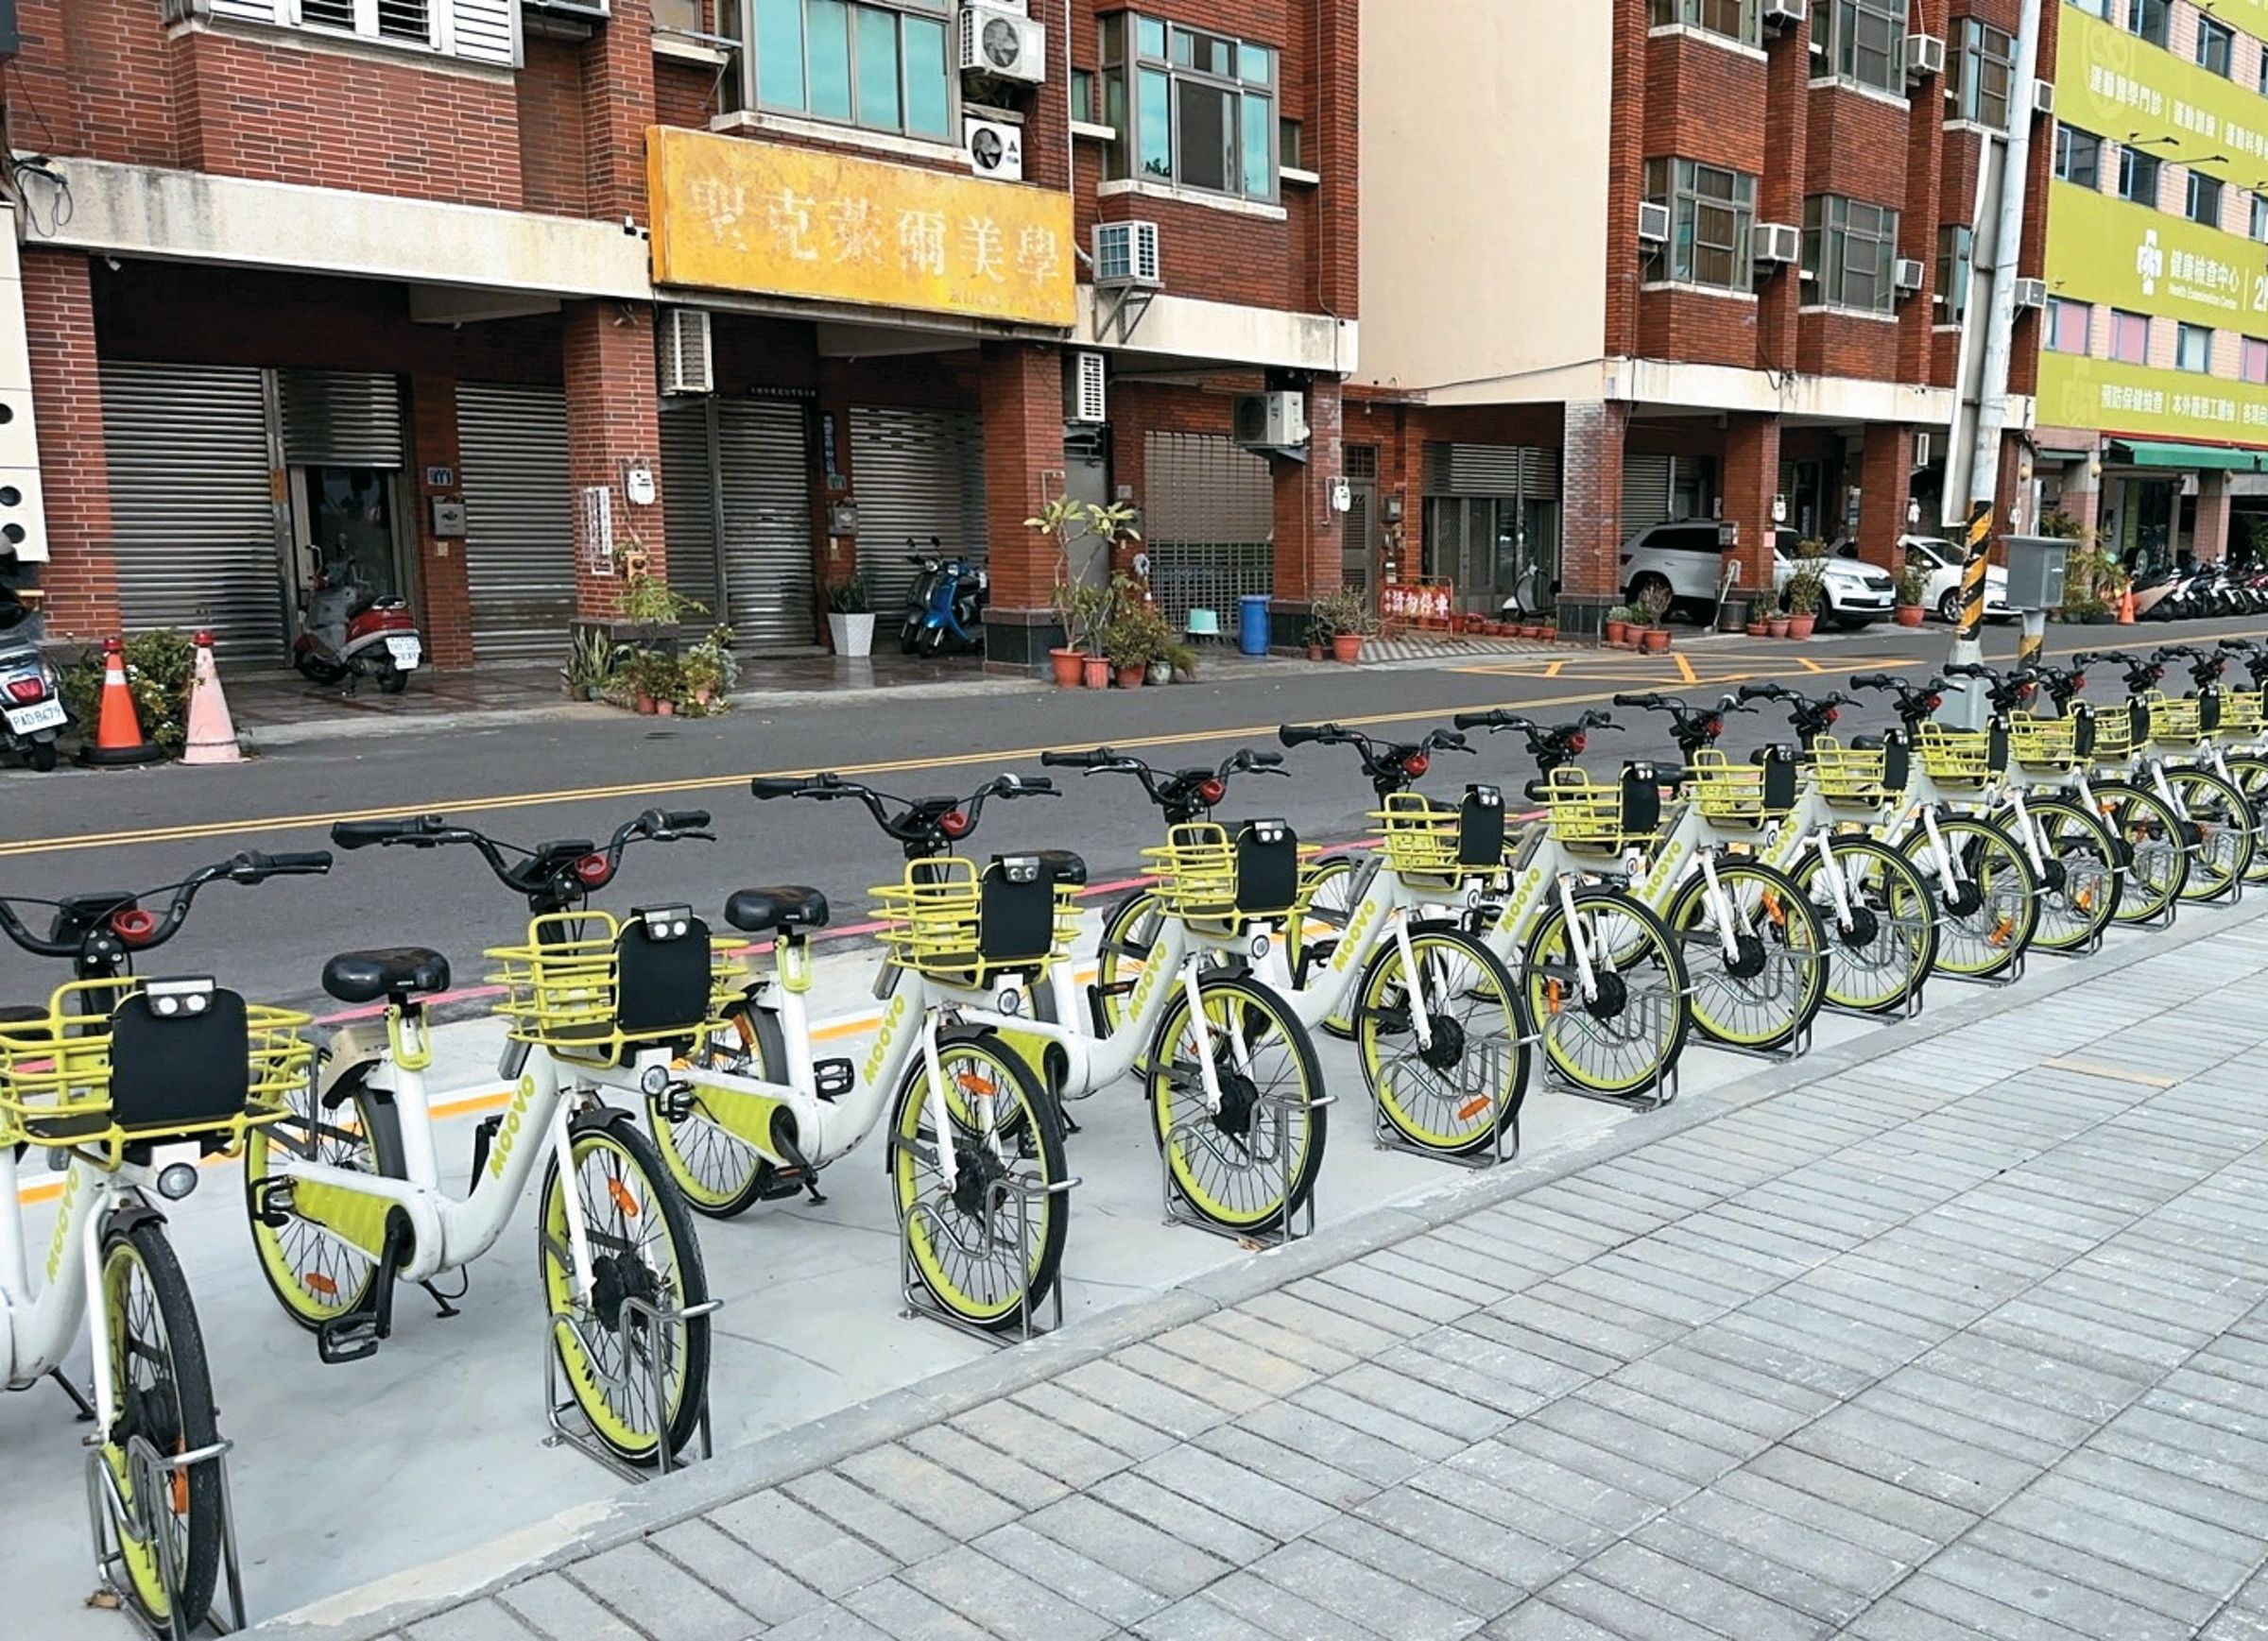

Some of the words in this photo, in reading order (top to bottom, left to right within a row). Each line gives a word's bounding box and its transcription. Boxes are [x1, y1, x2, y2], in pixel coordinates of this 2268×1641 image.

[2170, 248, 2240, 294] 健康檢查中心
[1392, 590, 1449, 616] 請勿停車
[1502, 867, 1540, 933] MOOVO
[1643, 841, 1682, 902] MOOVO
[1333, 900, 1376, 973] MOOVO
[1128, 942, 1167, 1023] MOOVO
[864, 995, 905, 1085] MOOVO
[490, 1073, 535, 1179] MOOVO
[47, 1164, 79, 1285] MOOVO
